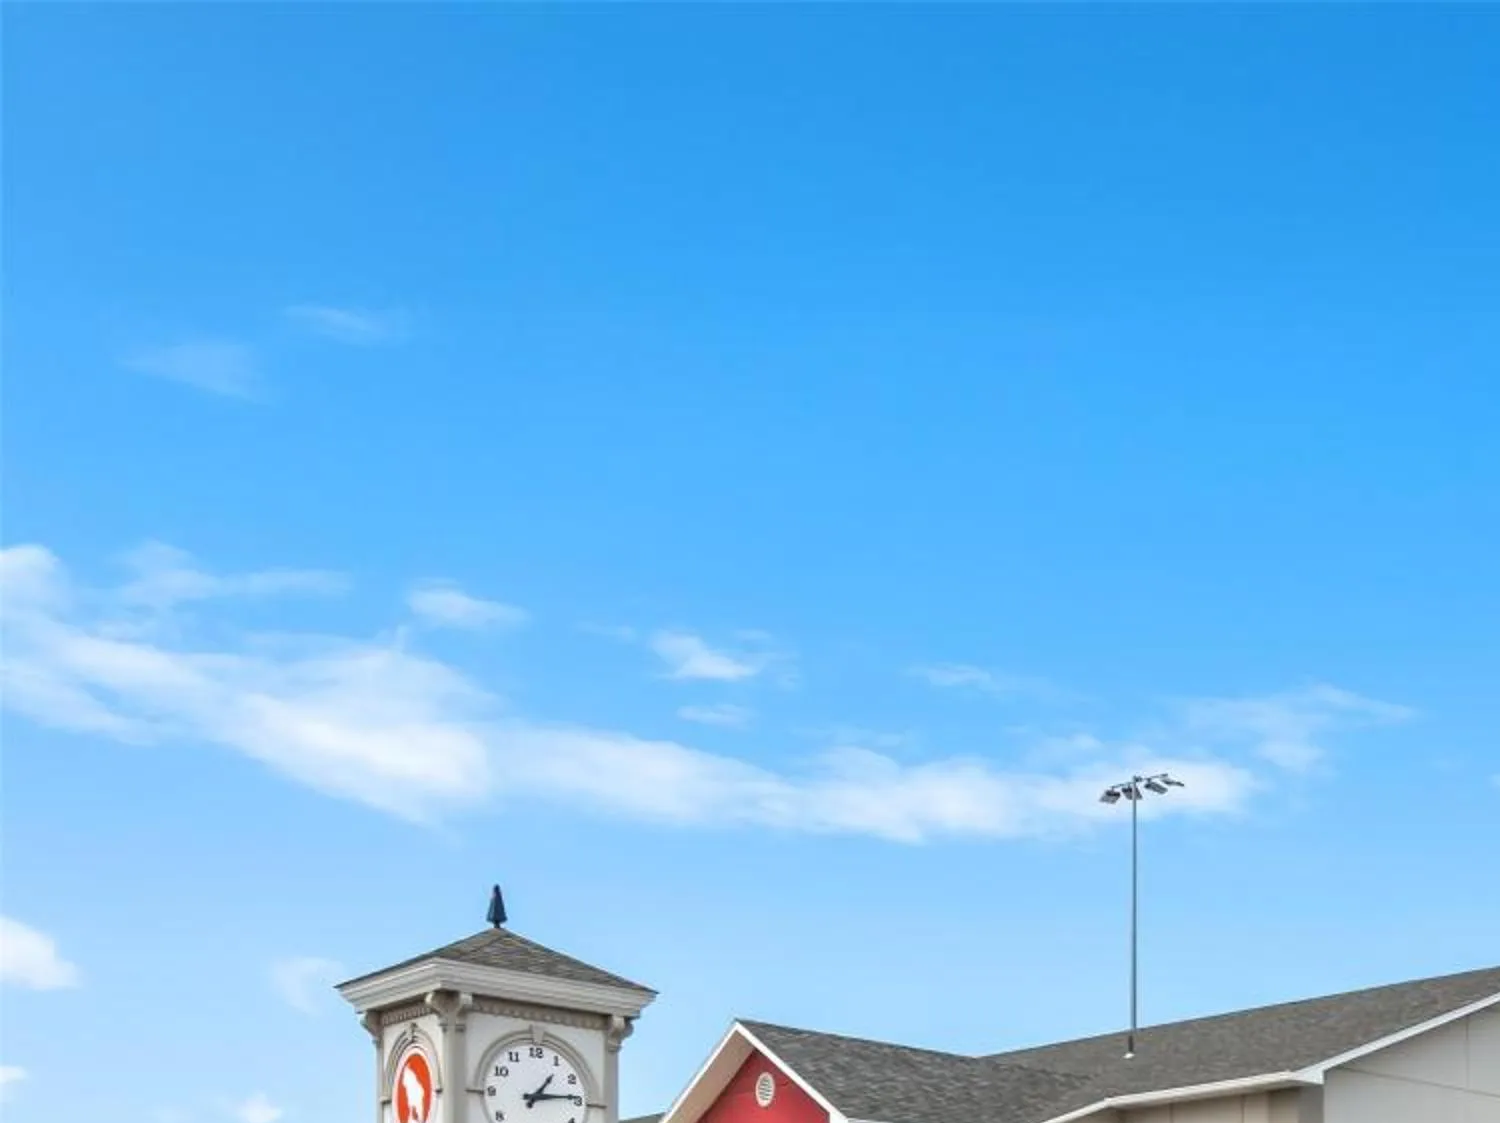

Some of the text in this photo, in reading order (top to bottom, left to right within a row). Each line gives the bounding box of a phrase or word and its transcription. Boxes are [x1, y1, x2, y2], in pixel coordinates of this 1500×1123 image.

[508, 1051, 520, 1063] 11
[529, 1047, 544, 1059] 12
[553, 1055, 560, 1067] 1
[494, 1065, 509, 1077] 10
[567, 1073, 577, 1085] 2
[487, 1085, 497, 1097] 9
[573, 1095, 583, 1107] 3
[495, 1111, 505, 1122] 8
